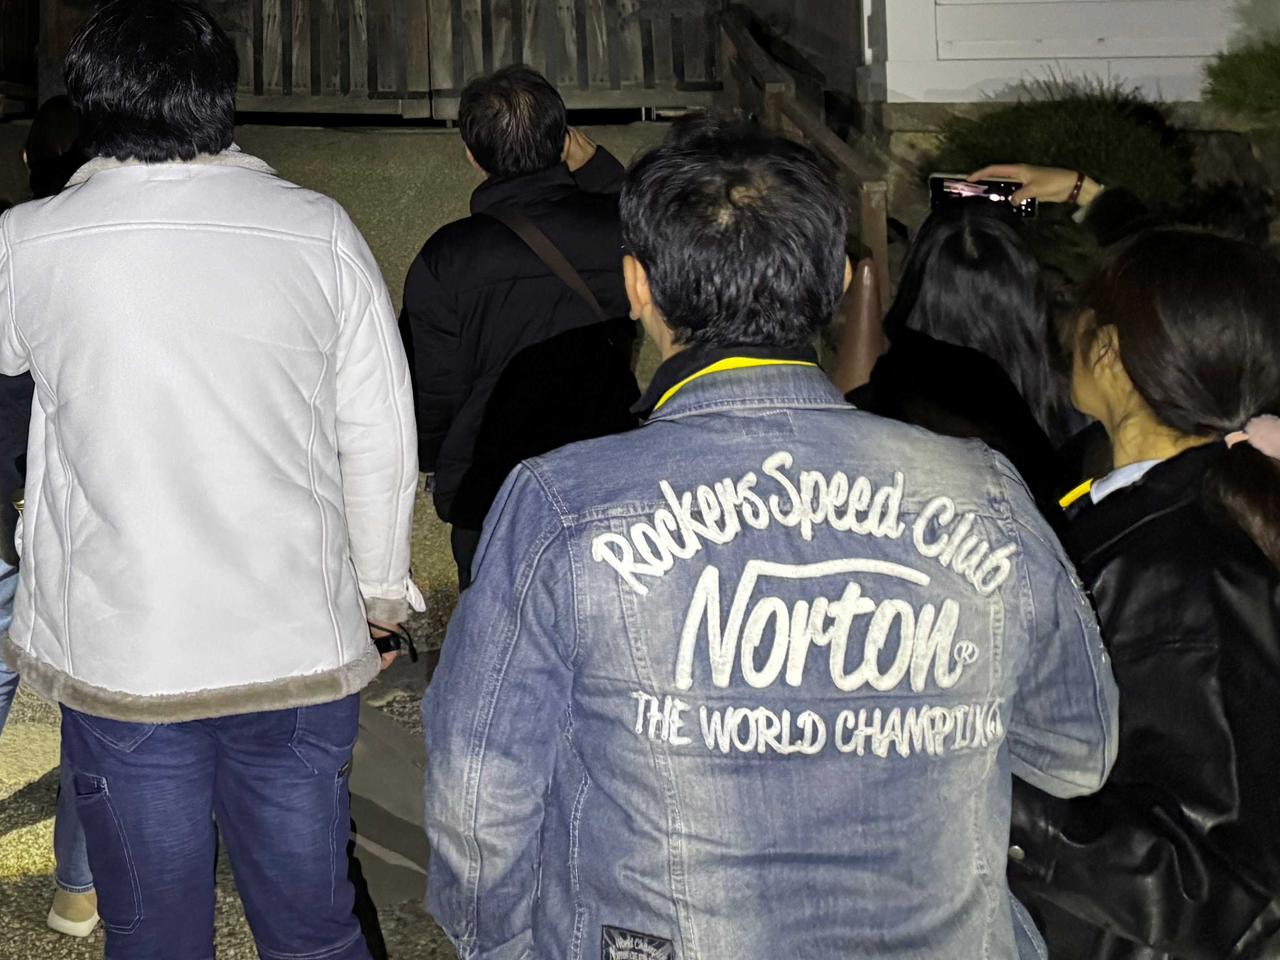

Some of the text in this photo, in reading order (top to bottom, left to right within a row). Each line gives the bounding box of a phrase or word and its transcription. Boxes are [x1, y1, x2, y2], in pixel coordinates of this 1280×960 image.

[591, 451, 1018, 596] Rockers Speed Club
[631, 690, 693, 746] THE
[699, 705, 827, 756] WORLD
